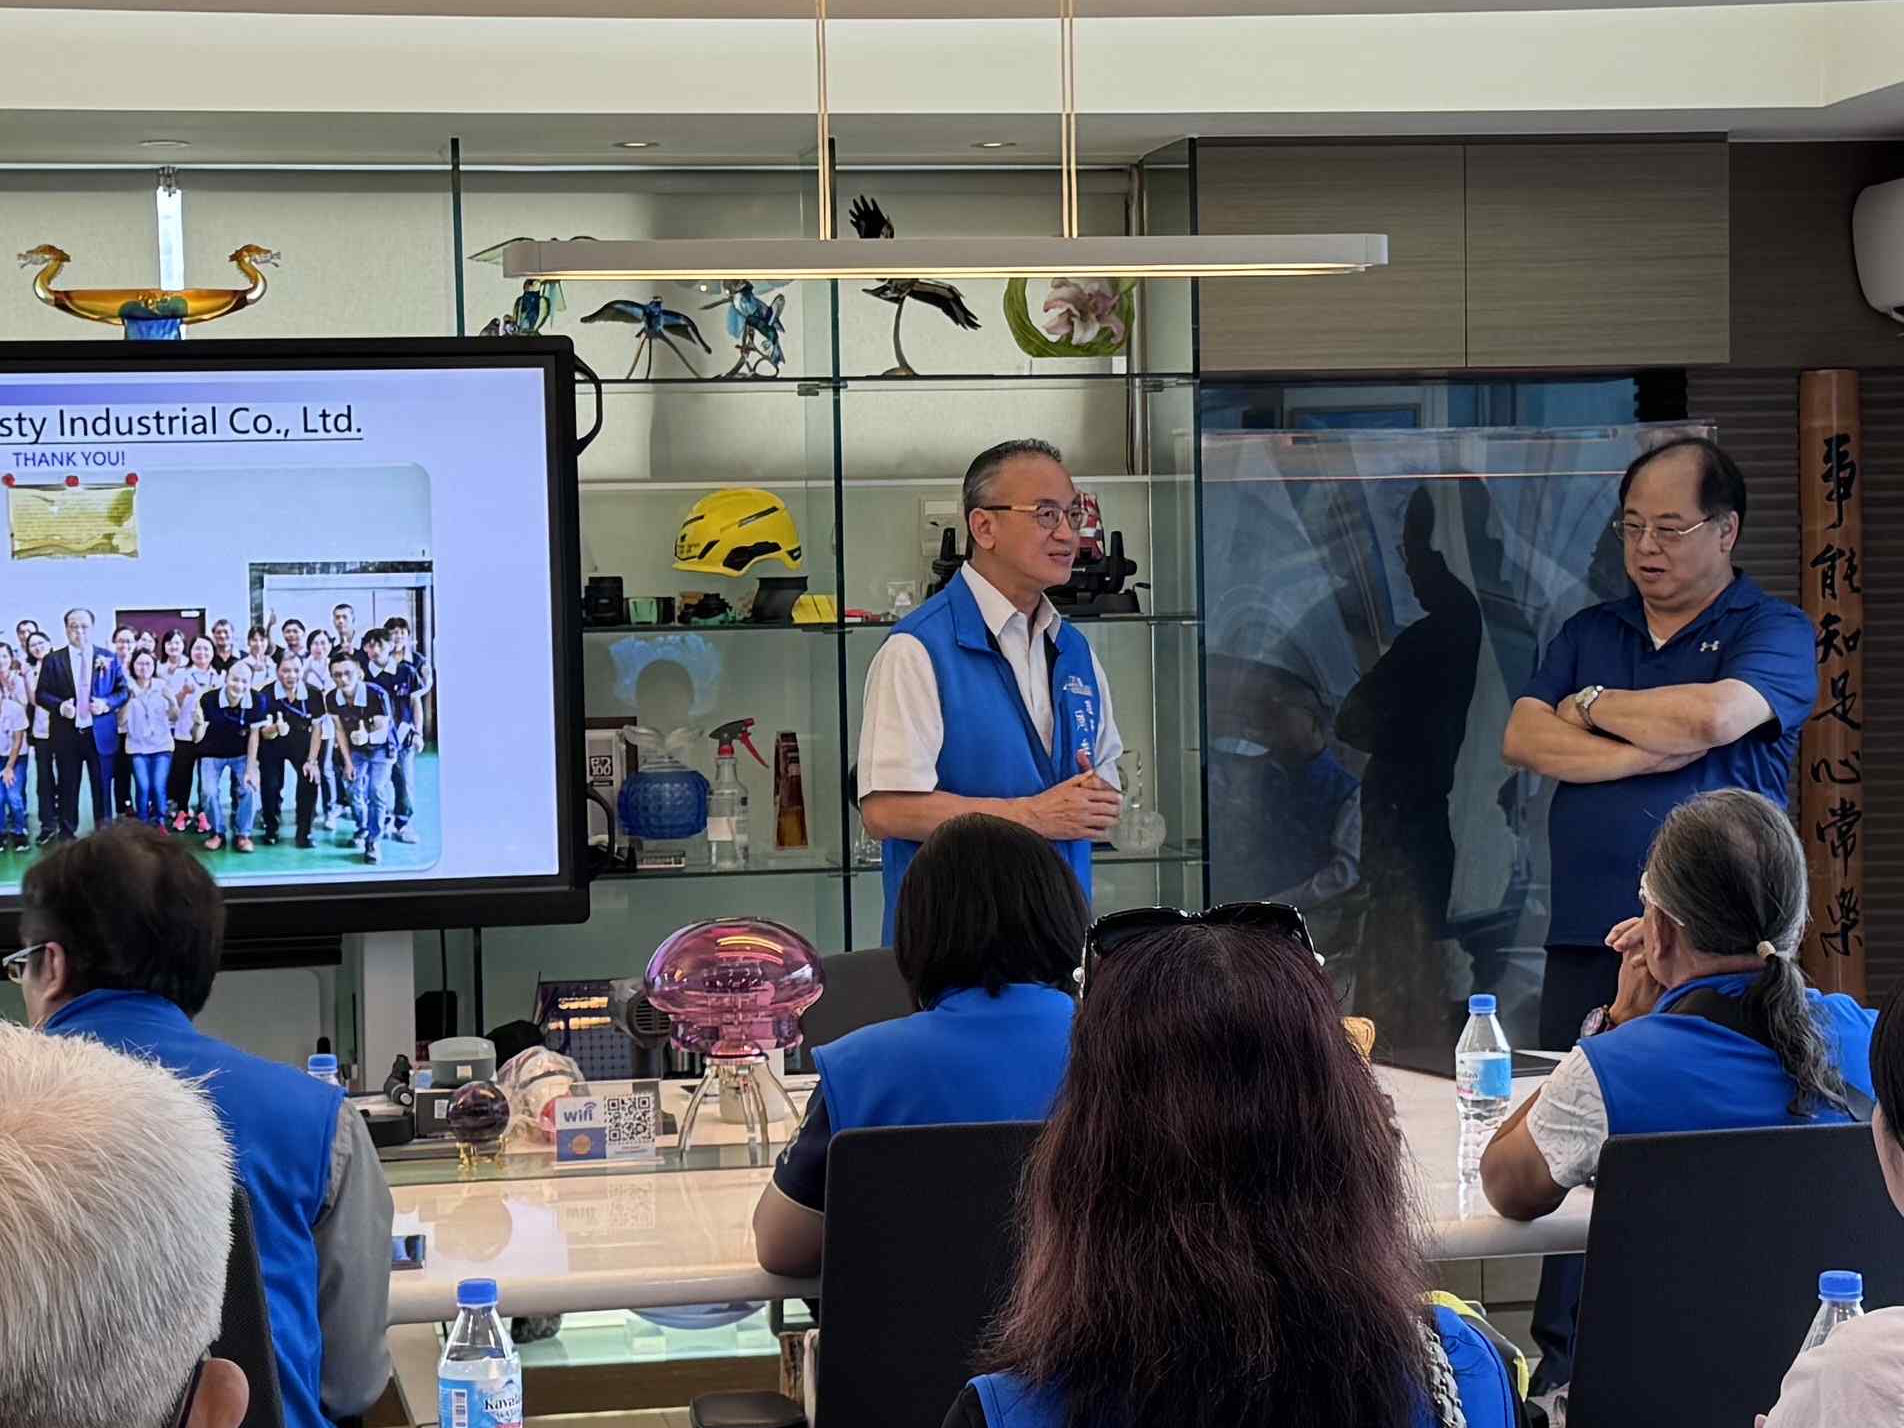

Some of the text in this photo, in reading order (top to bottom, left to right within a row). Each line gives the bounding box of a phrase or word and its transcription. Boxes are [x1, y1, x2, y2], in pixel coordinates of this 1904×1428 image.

[59, 406, 217, 437] Industrial
[228, 406, 290, 439] Co.,
[302, 404, 363, 434] Ltd.
[12, 451, 126, 467] THANK YOU!
